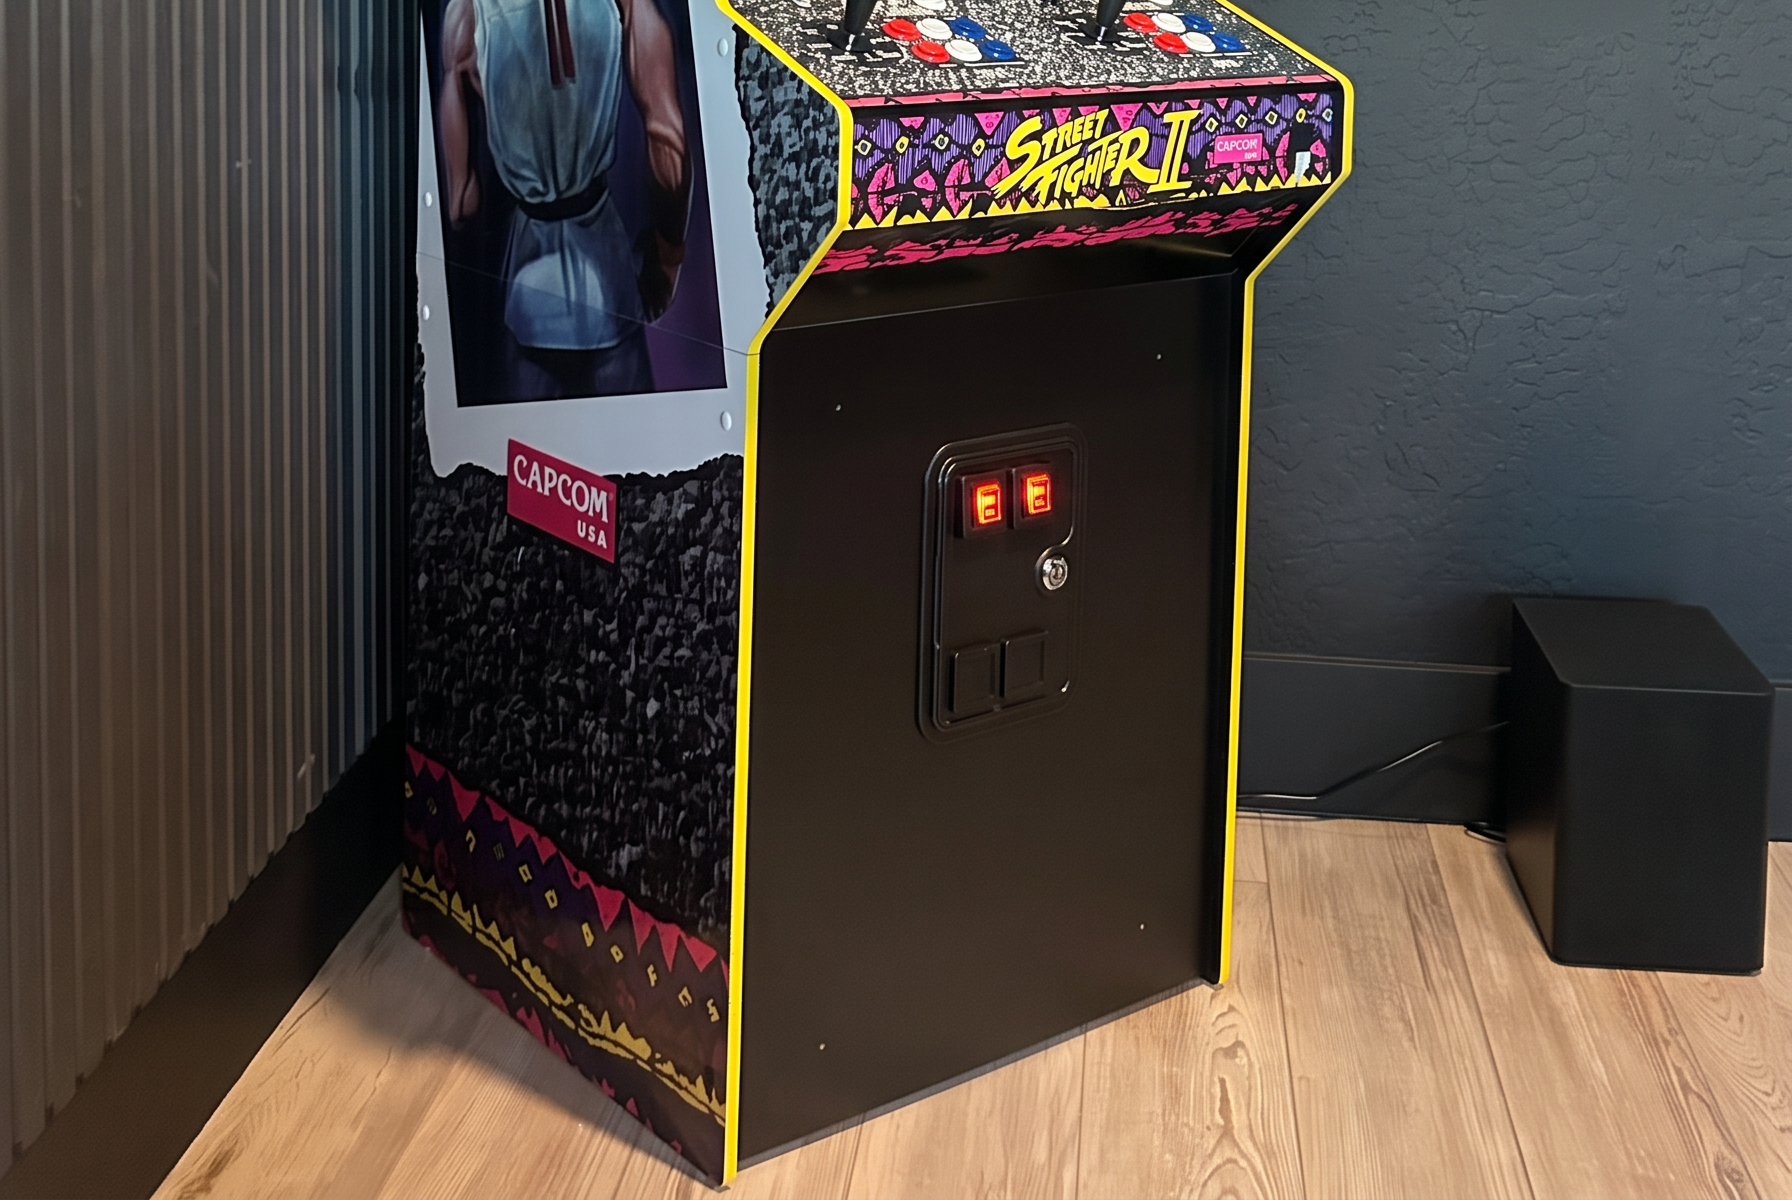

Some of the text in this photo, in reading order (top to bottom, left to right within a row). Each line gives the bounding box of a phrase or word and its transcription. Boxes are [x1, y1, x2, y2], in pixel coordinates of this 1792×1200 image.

[990, 108, 1110, 199] STREET
[1017, 108, 1203, 204] FIGHTER II
[513, 454, 609, 523] CAPCOM
[577, 519, 607, 549] USA
